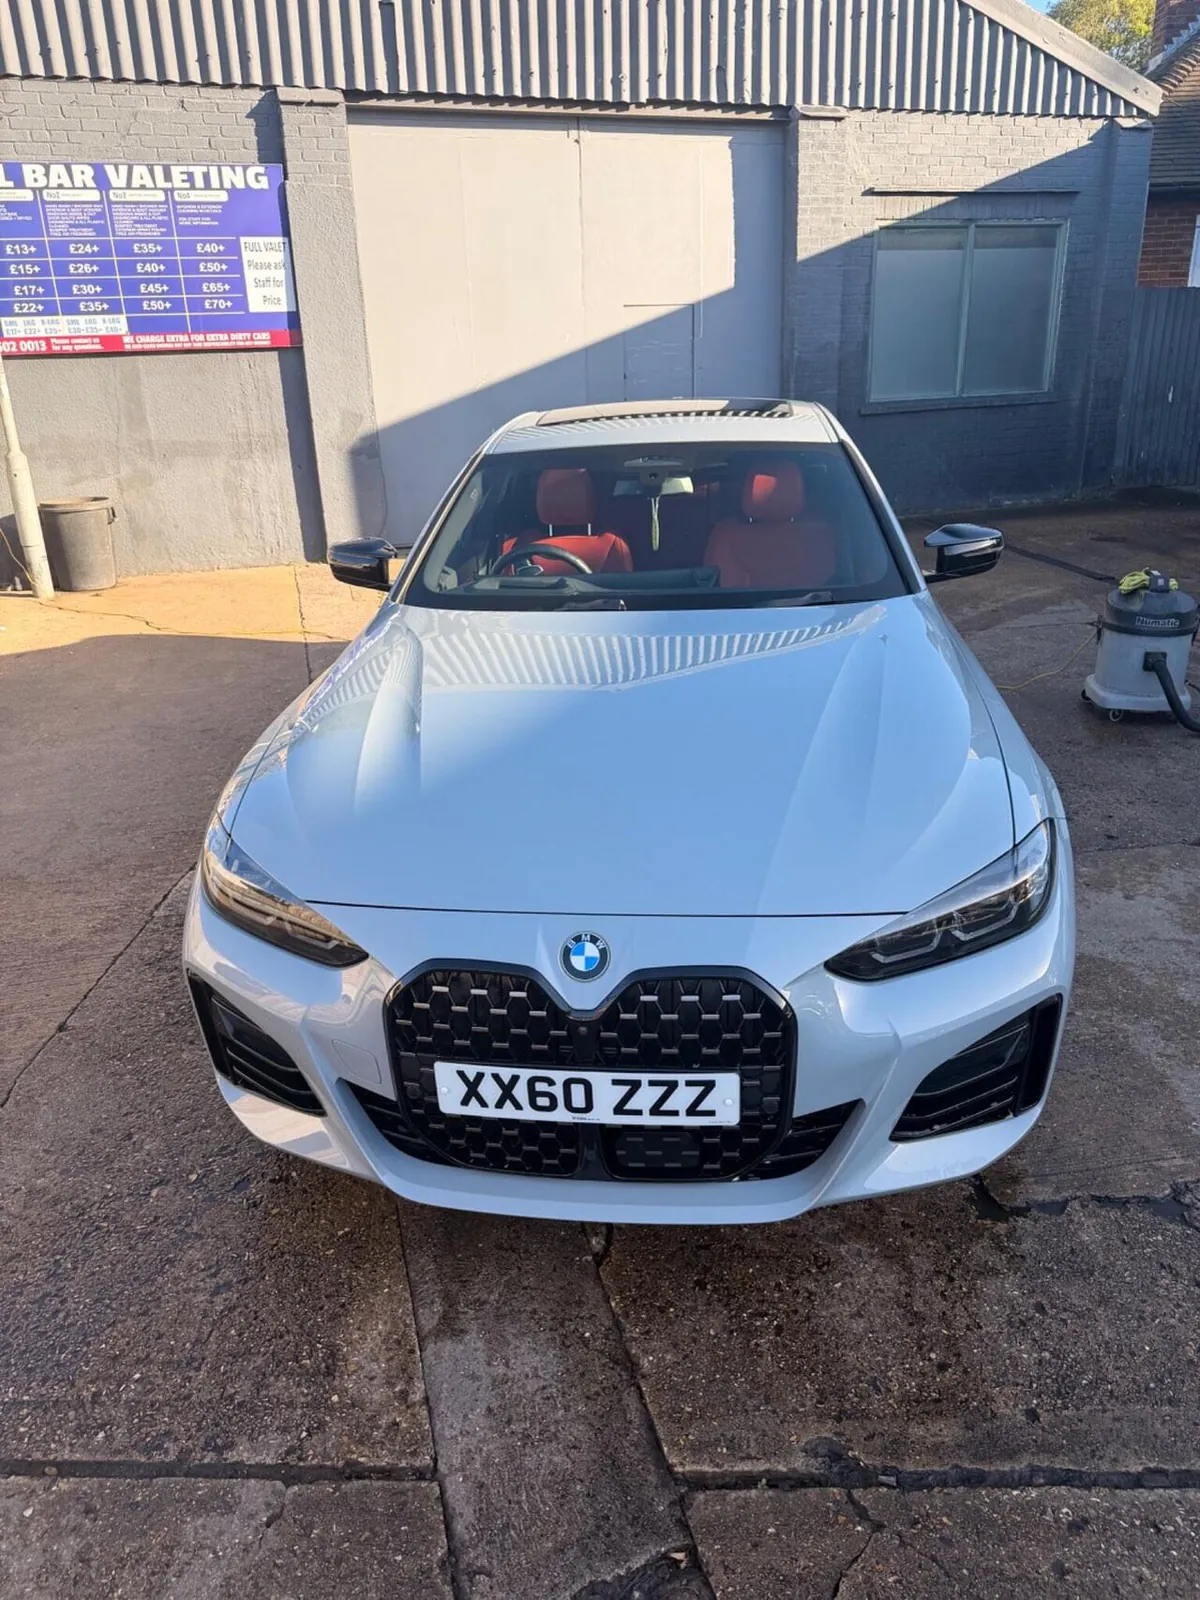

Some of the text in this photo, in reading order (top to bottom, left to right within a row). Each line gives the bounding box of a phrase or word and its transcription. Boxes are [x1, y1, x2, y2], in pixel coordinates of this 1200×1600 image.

[22, 164, 97, 188] BAR
[104, 164, 269, 190] VALETING
[6, 244, 36, 254] £13+
[69, 244, 100, 254] £24+
[133, 243, 163, 253] £35+
[197, 243, 225, 253] £40+
[244, 242, 286, 252] FULL VALET
[10, 264, 41, 274] £15+
[69, 264, 99, 273] £26+
[136, 263, 166, 273] £40+
[199, 262, 228, 272] £50+
[247, 260, 272, 270] Please
[202, 283, 231, 292] £65+
[254, 277, 284, 288] Staff for
[14, 285, 45, 295] £17+
[72, 284, 103, 294] £30+
[140, 284, 169, 293] £45+
[143, 301, 172, 310] £50+
[204, 299, 232, 309] £70+
[263, 295, 282, 306] Price
[14, 303, 44, 313] £22+
[80, 302, 109, 311] £35+
[190, 334, 204, 342] FOR
[20, 340, 47, 352] 0013
[1136, 617, 1180, 628] Numatic
[567, 934, 606, 949] BMW
[456, 1070, 716, 1117] XX60 ZZZ
